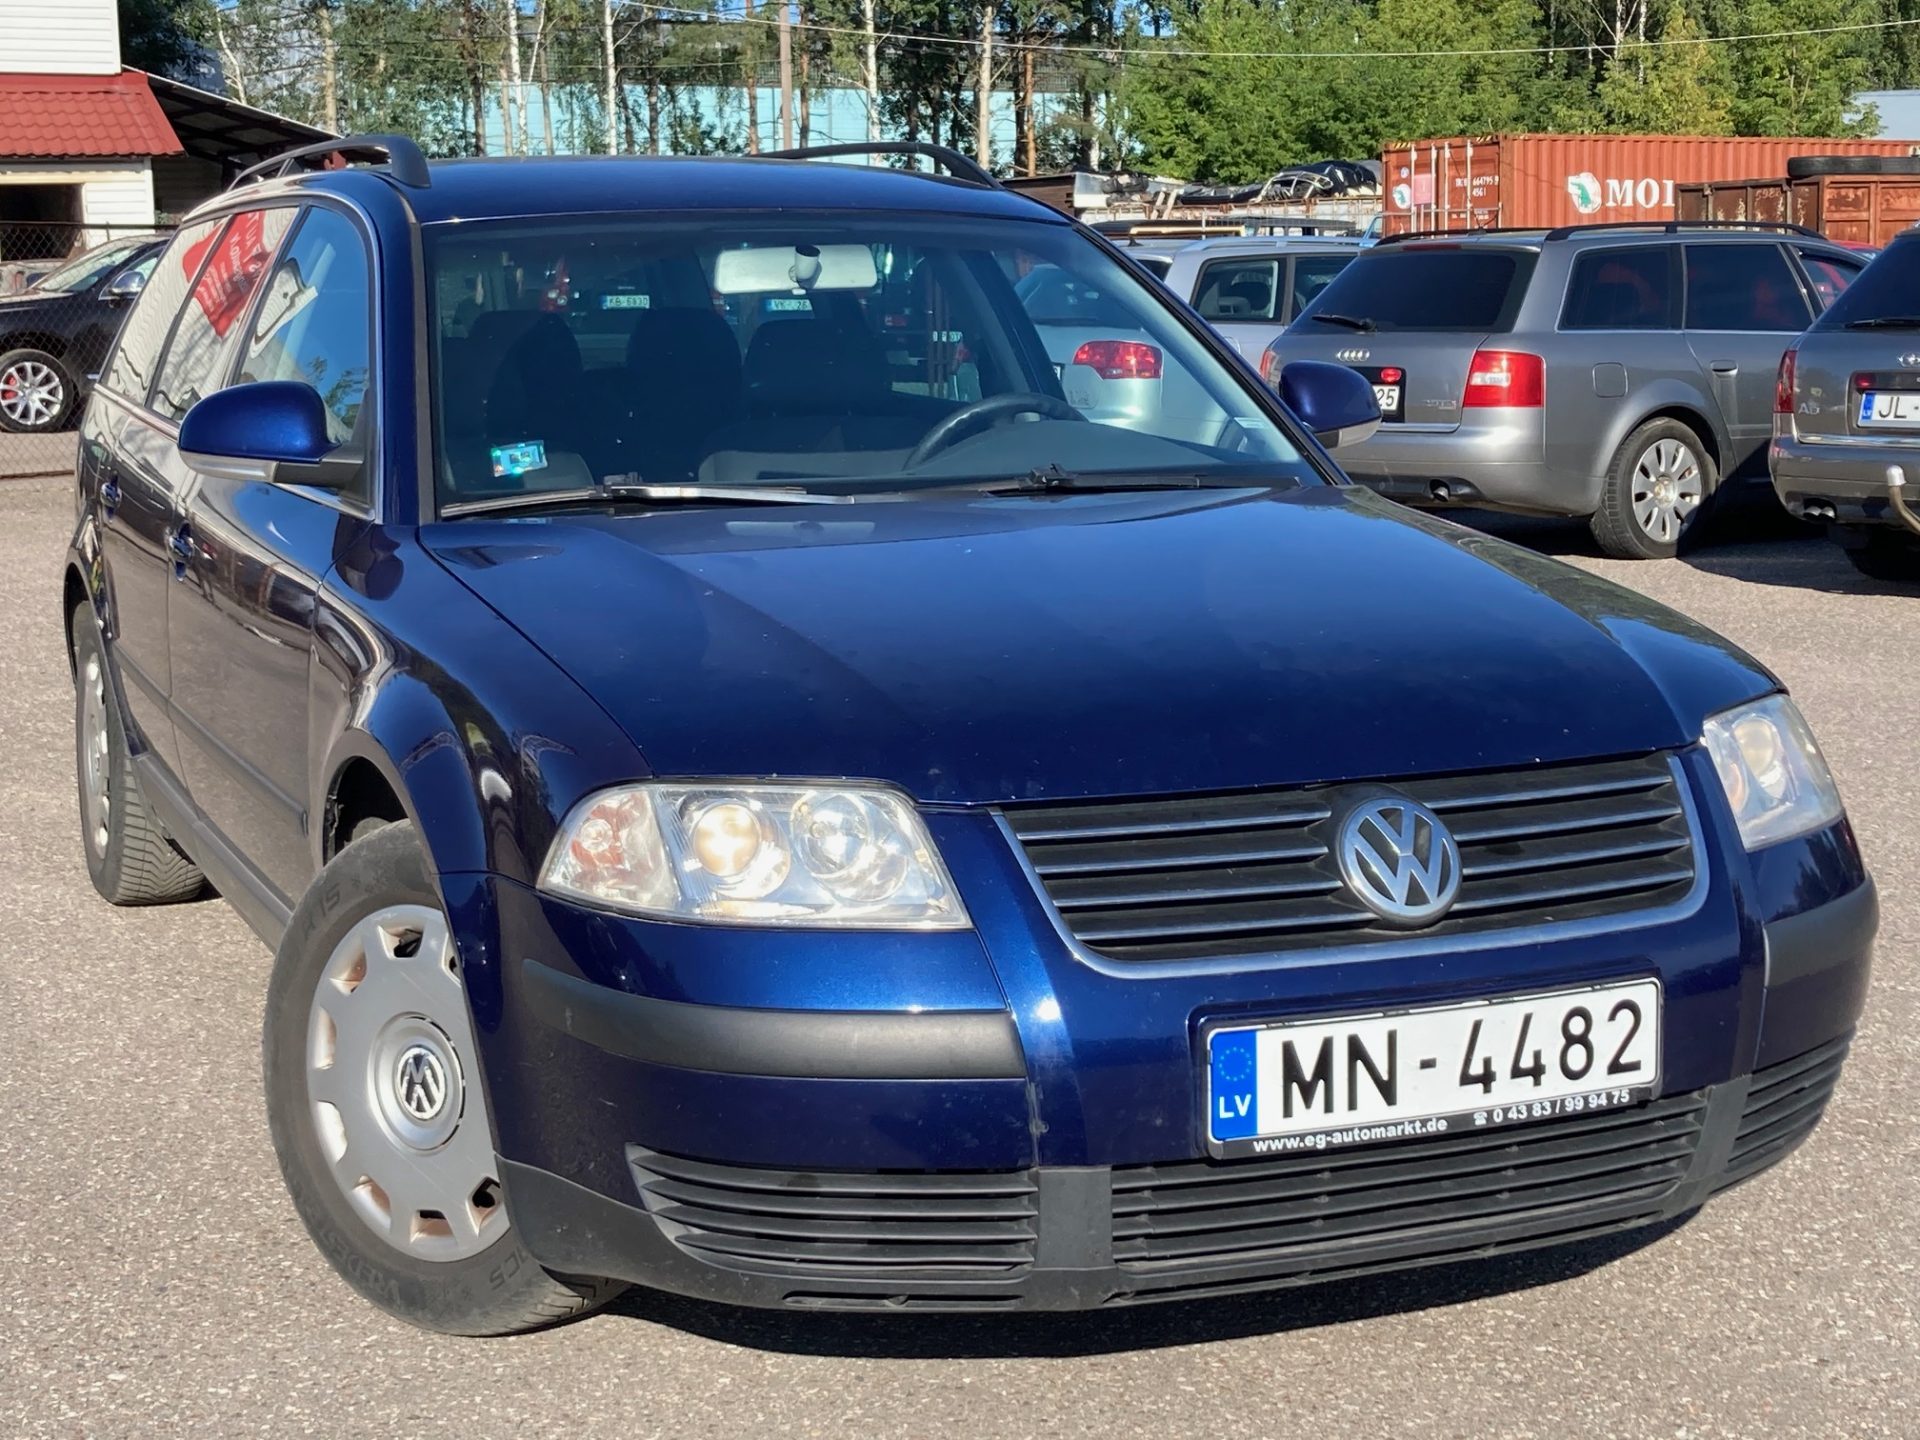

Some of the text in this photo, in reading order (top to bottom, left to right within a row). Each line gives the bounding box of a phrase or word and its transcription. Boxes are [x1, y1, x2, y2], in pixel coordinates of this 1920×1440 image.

[1219, 1094, 1252, 1119] LV
[1253, 1117, 1448, 1152] www.eg-automarkt.de
[1493, 1108, 1504, 1123] 0
[1507, 1104, 1528, 1120] 43
[1532, 1101, 1551, 1117] 83
[1564, 1095, 1584, 1112] 99
[1588, 1092, 1608, 1108] 94
[1611, 1088, 1630, 1105] 75
